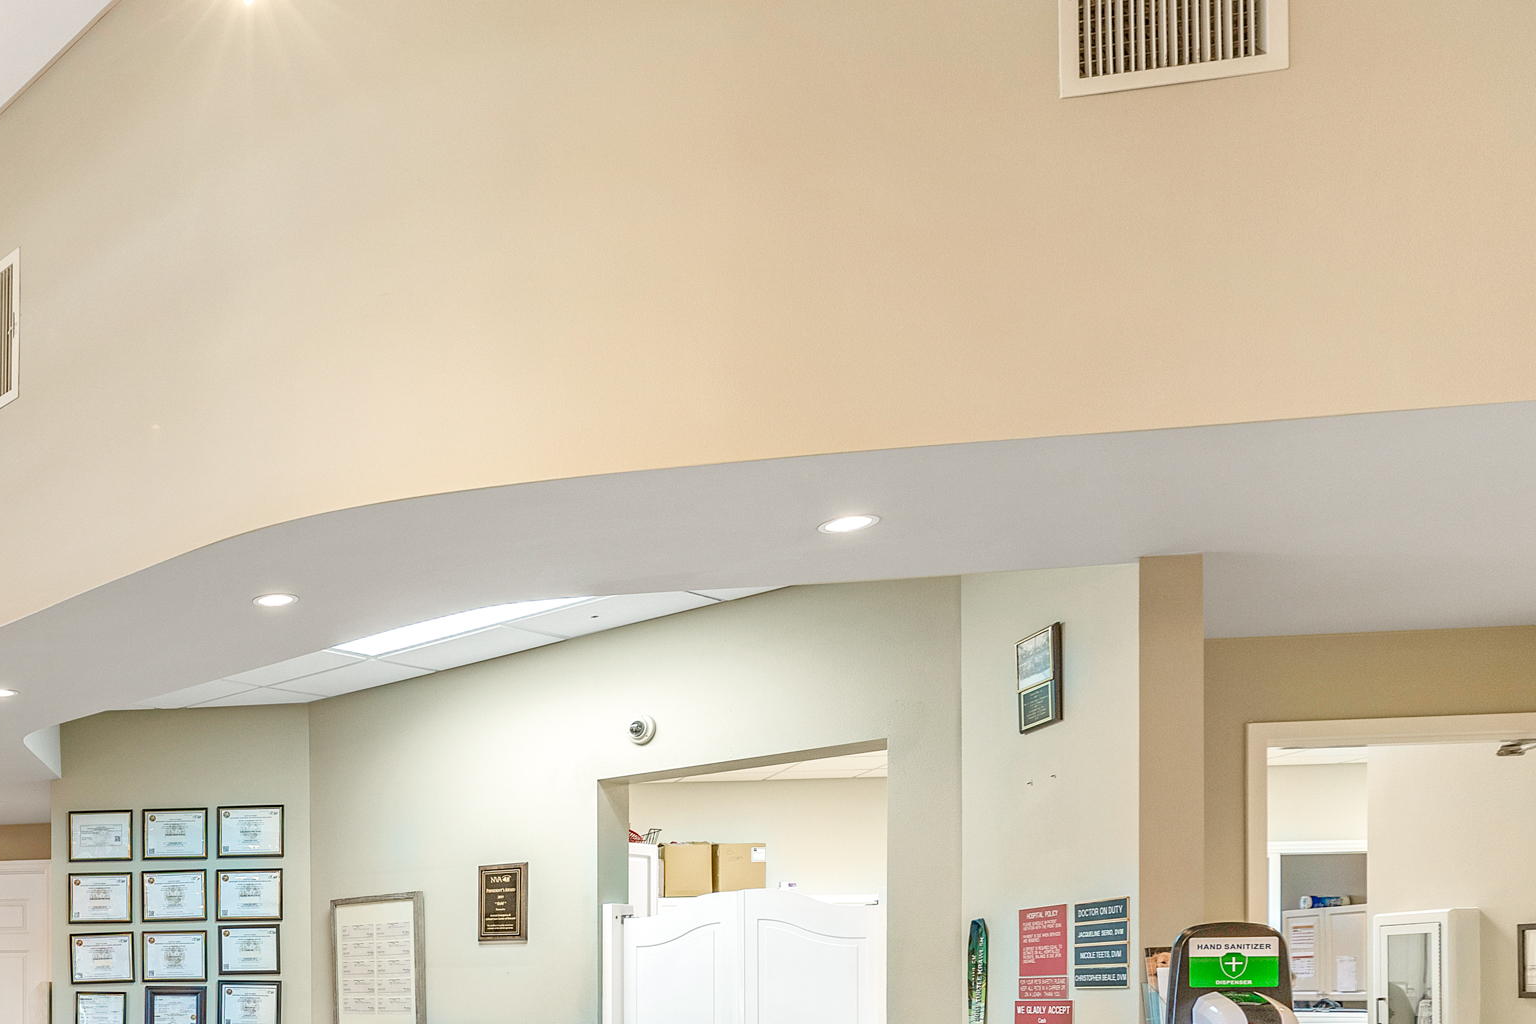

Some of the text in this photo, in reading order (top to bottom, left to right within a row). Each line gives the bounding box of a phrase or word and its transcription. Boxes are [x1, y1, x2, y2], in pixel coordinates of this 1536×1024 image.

[1078, 905, 1123, 917] DOCTOR ON DUTY
[975, 975, 983, 1003] TURTLE
[1016, 1006, 1070, 1014] WE GLADLY ACCEPT
